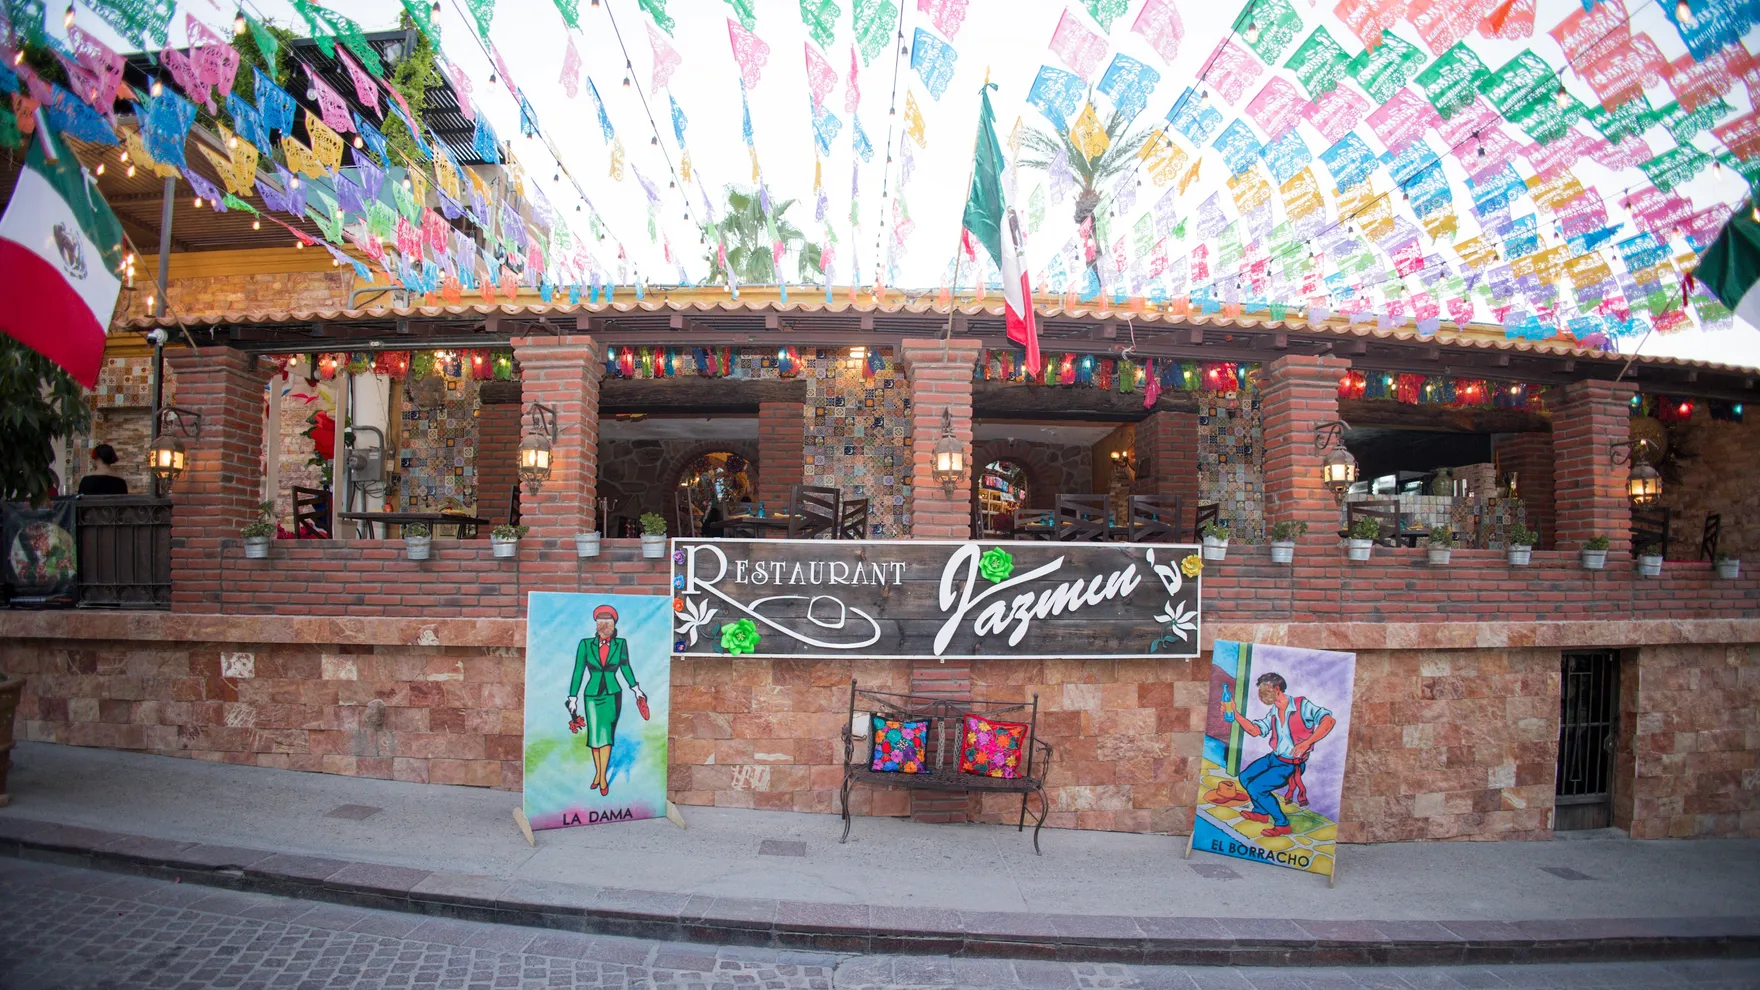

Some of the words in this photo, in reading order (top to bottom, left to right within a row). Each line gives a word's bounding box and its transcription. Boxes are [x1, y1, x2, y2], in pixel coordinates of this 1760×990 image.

[562, 813, 582, 826] LA
[588, 808, 633, 823] DAMA
[1211, 839, 1224, 851] EL
[1228, 843, 1310, 867] BORRACHO
